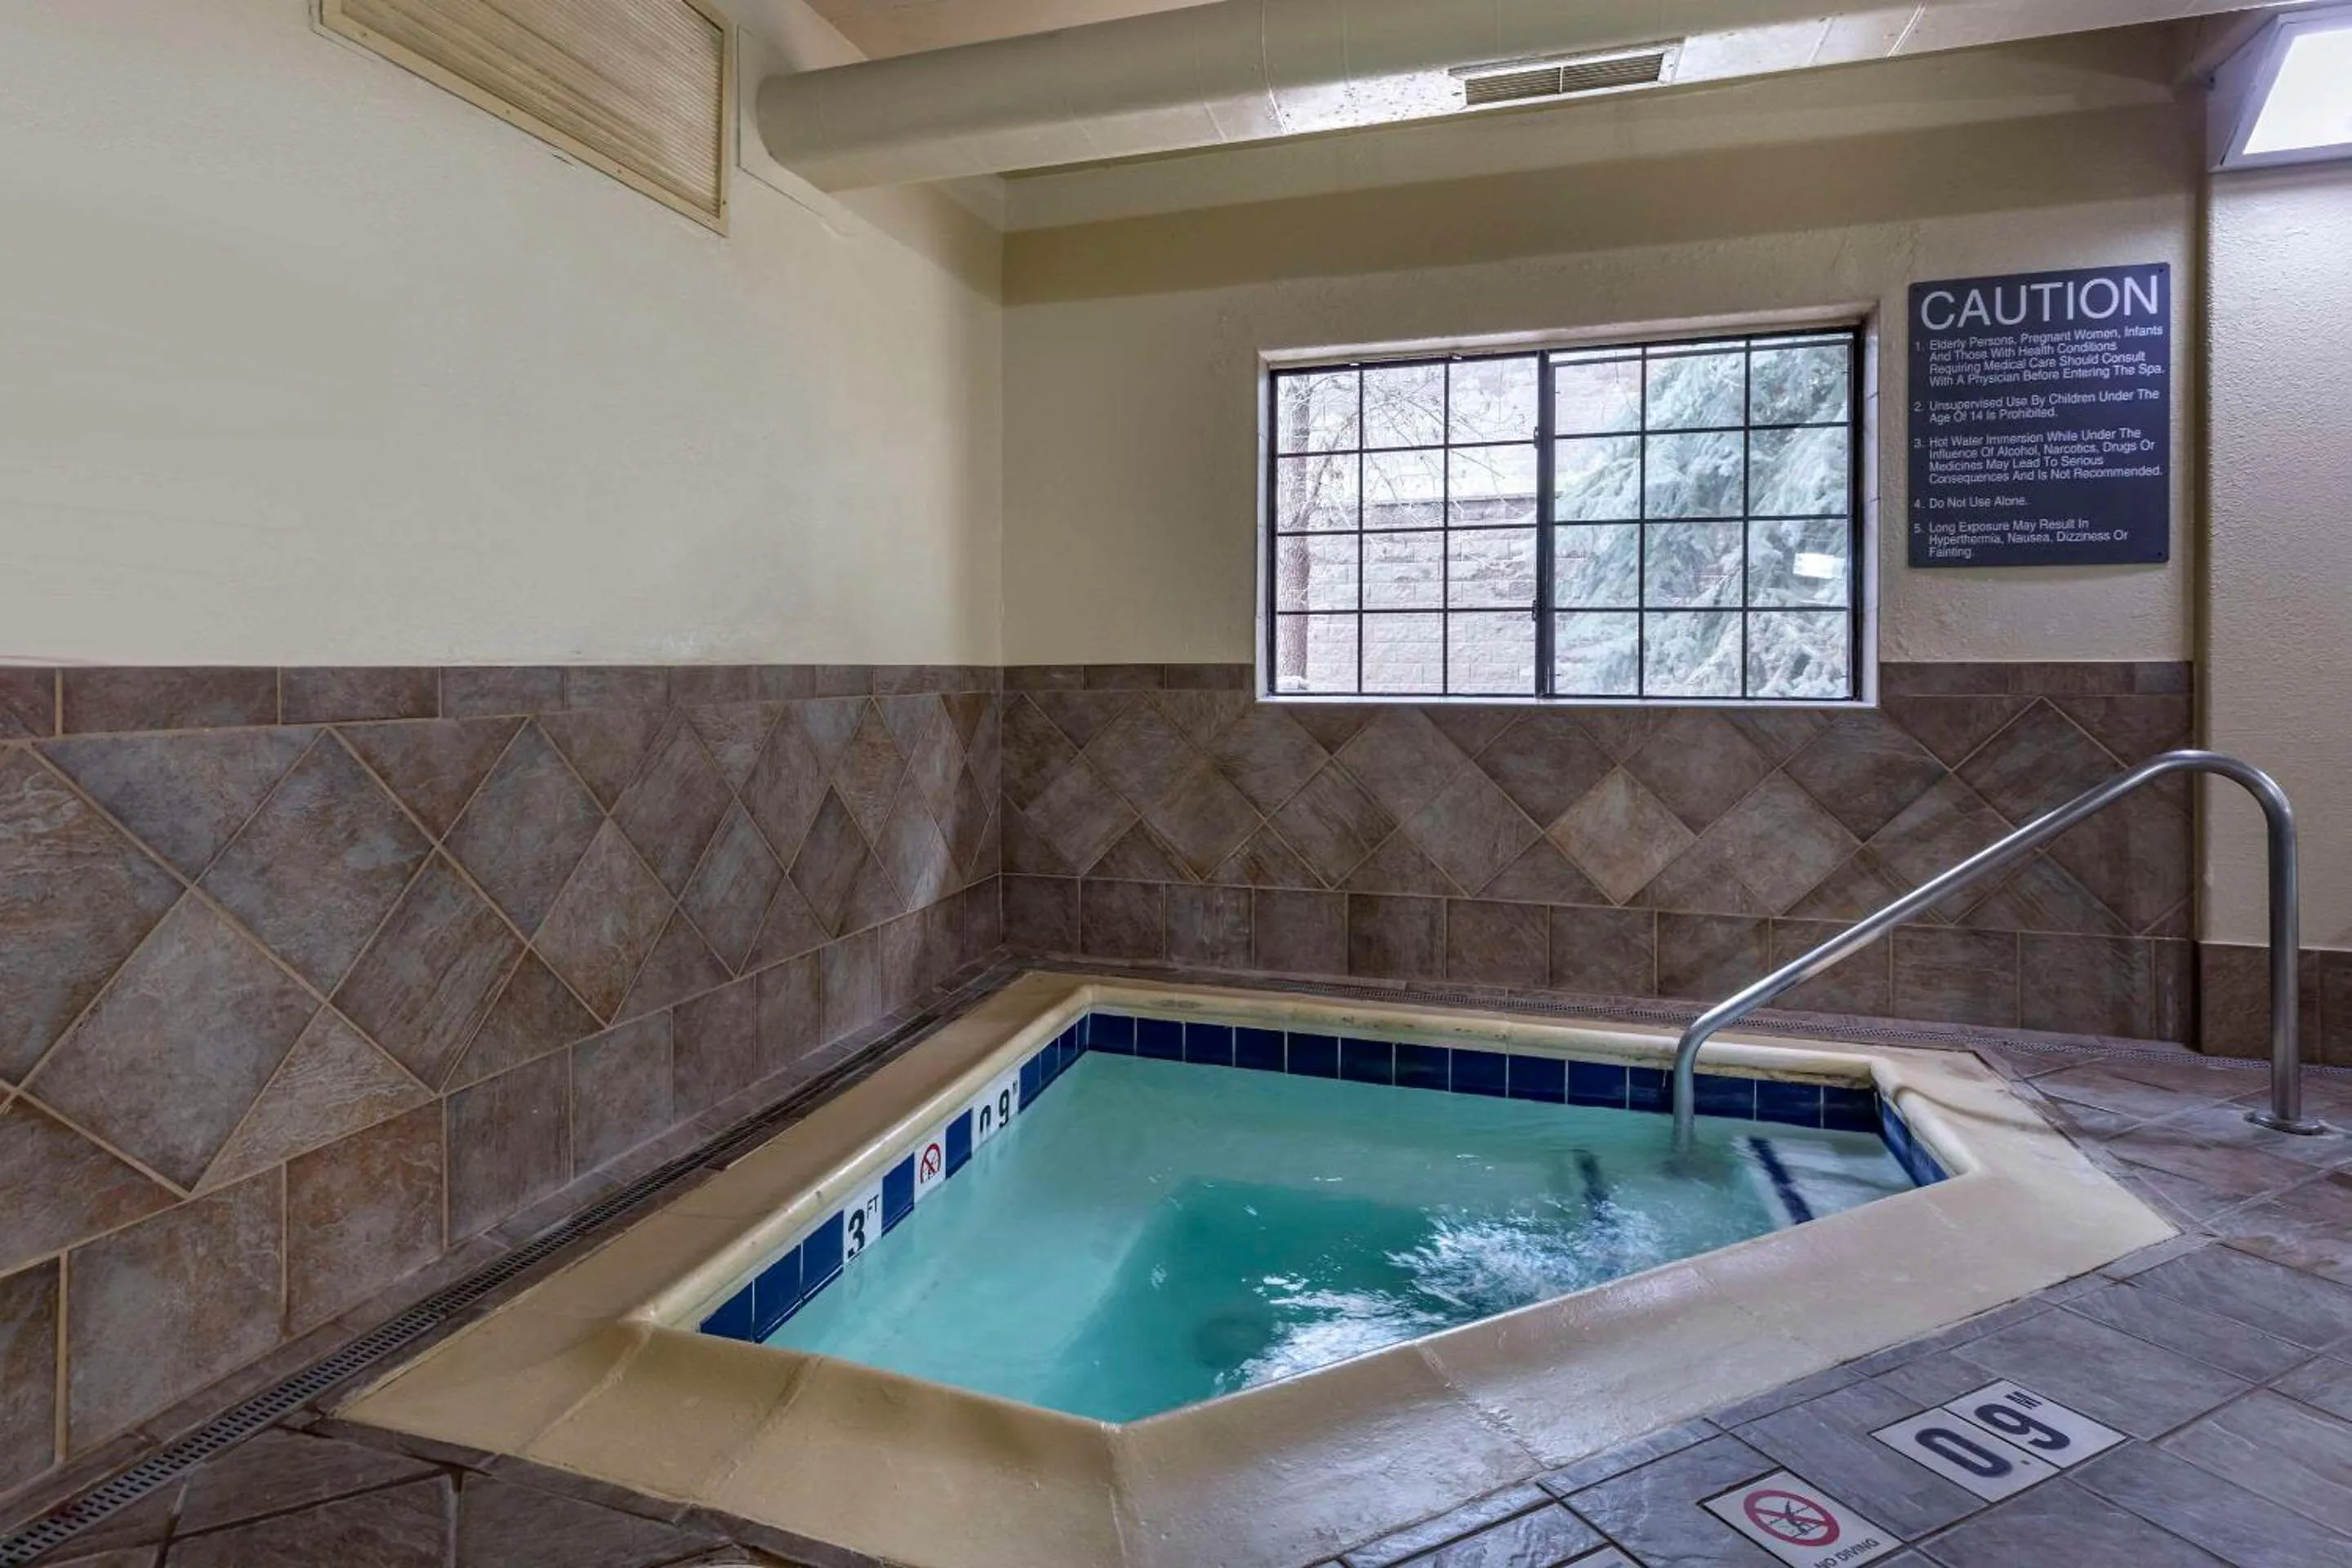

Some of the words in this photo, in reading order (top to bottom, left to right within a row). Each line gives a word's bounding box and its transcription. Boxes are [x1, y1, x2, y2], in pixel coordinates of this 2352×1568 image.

[1921, 274, 2158, 331] CAUTION
[1930, 339, 1967, 350] Elderly
[2020, 332, 2072, 345] Pregnant
[2074, 328, 2122, 341] Women,
[2124, 326, 2164, 337] Infants
[1930, 352, 1952, 362] And
[1955, 350, 1988, 360] Those
[1990, 347, 2016, 358] With
[2018, 345, 2055, 356] Health
[2057, 341, 2118, 354] Conditions
[1930, 362, 1981, 376] Requiring
[1984, 360, 2027, 371] Medical
[2029, 357, 2057, 368] Care
[2060, 354, 2100, 367] Should
[2102, 350, 2146, 364] Consult
[1930, 376, 1954, 386] With
[1957, 374, 1965, 385] A
[1968, 372, 2020, 386] Physician
[2023, 370, 2060, 382] Before
[2063, 367, 2110, 380] Entering
[2113, 365, 2136, 376] The
[2138, 363, 2165, 377] Spa.
[1930, 396, 2003, 412] Unsupervised
[2007, 396, 2028, 407] Use
[2031, 394, 2046, 407] By
[2049, 391, 2096, 404] Children
[2099, 390, 2134, 402] Under
[2136, 388, 2160, 400] The
[1930, 413, 1951, 425] Age
[1953, 411, 1967, 421] Of
[1971, 410, 1983, 421] 14
[1986, 409, 1997, 421] Is
[1999, 407, 2058, 420] Prohibited.
[1930, 437, 1949, 448] Hot
[1951, 435, 1984, 447] Water
[1986, 433, 2043, 445] Immersion
[2047, 430, 2078, 442] While
[2082, 429, 2116, 441] Under
[2118, 427, 2141, 439] The
[1930, 448, 1978, 459] Influence
[1980, 447, 1994, 457] Of
[2103, 441, 2137, 454] Drugs
[2140, 439, 2156, 451] Or
[1930, 461, 1984, 472] Medicines
[1986, 459, 2010, 471] May
[2013, 458, 2041, 469] Lead
[2043, 456, 2058, 467] To
[2060, 455, 2105, 467] Serious
[1930, 473, 2009, 485] Consequences
[2012, 470, 2035, 481] And
[2038, 470, 2049, 480] Is
[2051, 468, 2071, 479] Not
[2074, 464, 2163, 479] Recommended.
[1930, 498, 1945, 509] Do
[1947, 497, 1967, 508] Not
[1969, 496, 1991, 507] Use
[1994, 496, 2029, 506] Alone.
[1930, 522, 1957, 536] Long
[1959, 520, 2010, 533] Exposure
[2013, 519, 2037, 533] May
[2040, 518, 2076, 530] Result
[2078, 518, 2090, 528] In
[2056, 530, 2111, 542] Dizziness
[2114, 529, 2130, 541] Or
[848, 1209, 866, 1259] 3
[866, 1194, 880, 1220] FT
[2004, 1391, 2043, 1410] M
[1834, 1539, 1880, 1562] DIVING
